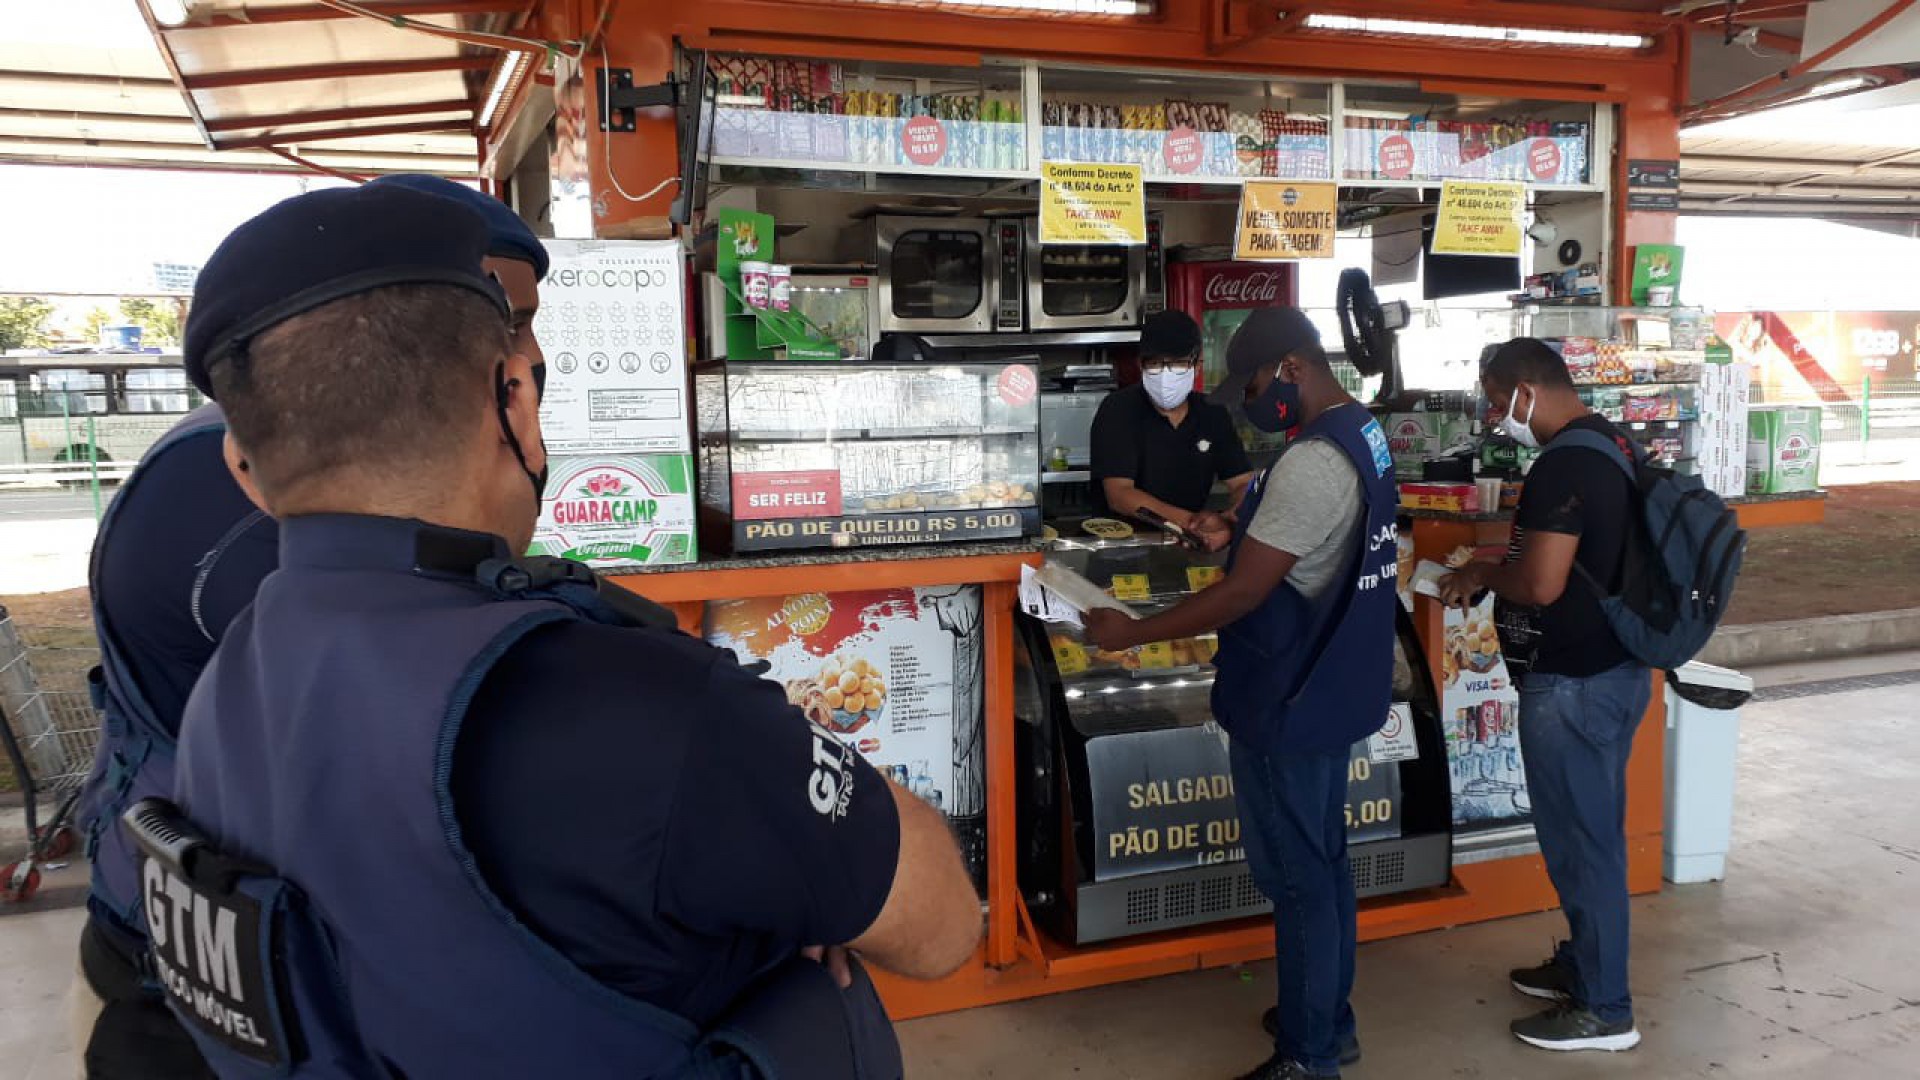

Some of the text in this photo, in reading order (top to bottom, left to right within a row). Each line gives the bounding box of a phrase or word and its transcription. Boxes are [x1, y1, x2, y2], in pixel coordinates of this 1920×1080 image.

[1049, 166, 1134, 180] Conforme Decreto
[1094, 209, 1122, 220] AWAY
[1283, 210, 1332, 229] SOMENTE
[1457, 223, 1504, 235] TAKE AWAY
[1249, 233, 1278, 252] PARA
[749, 491, 828, 507] SER FELIZ
[553, 498, 658, 524] GUARACAMP
[746, 521, 794, 540] PÃO
[802, 521, 834, 535] DE
[840, 519, 920, 536] QUEIJO
[928, 517, 957, 532] R$
[1464, 680, 1489, 692] VISA
[1109, 826, 1159, 859] PÃO
[1167, 823, 1200, 851] DE
[144, 856, 244, 1002] GTM
